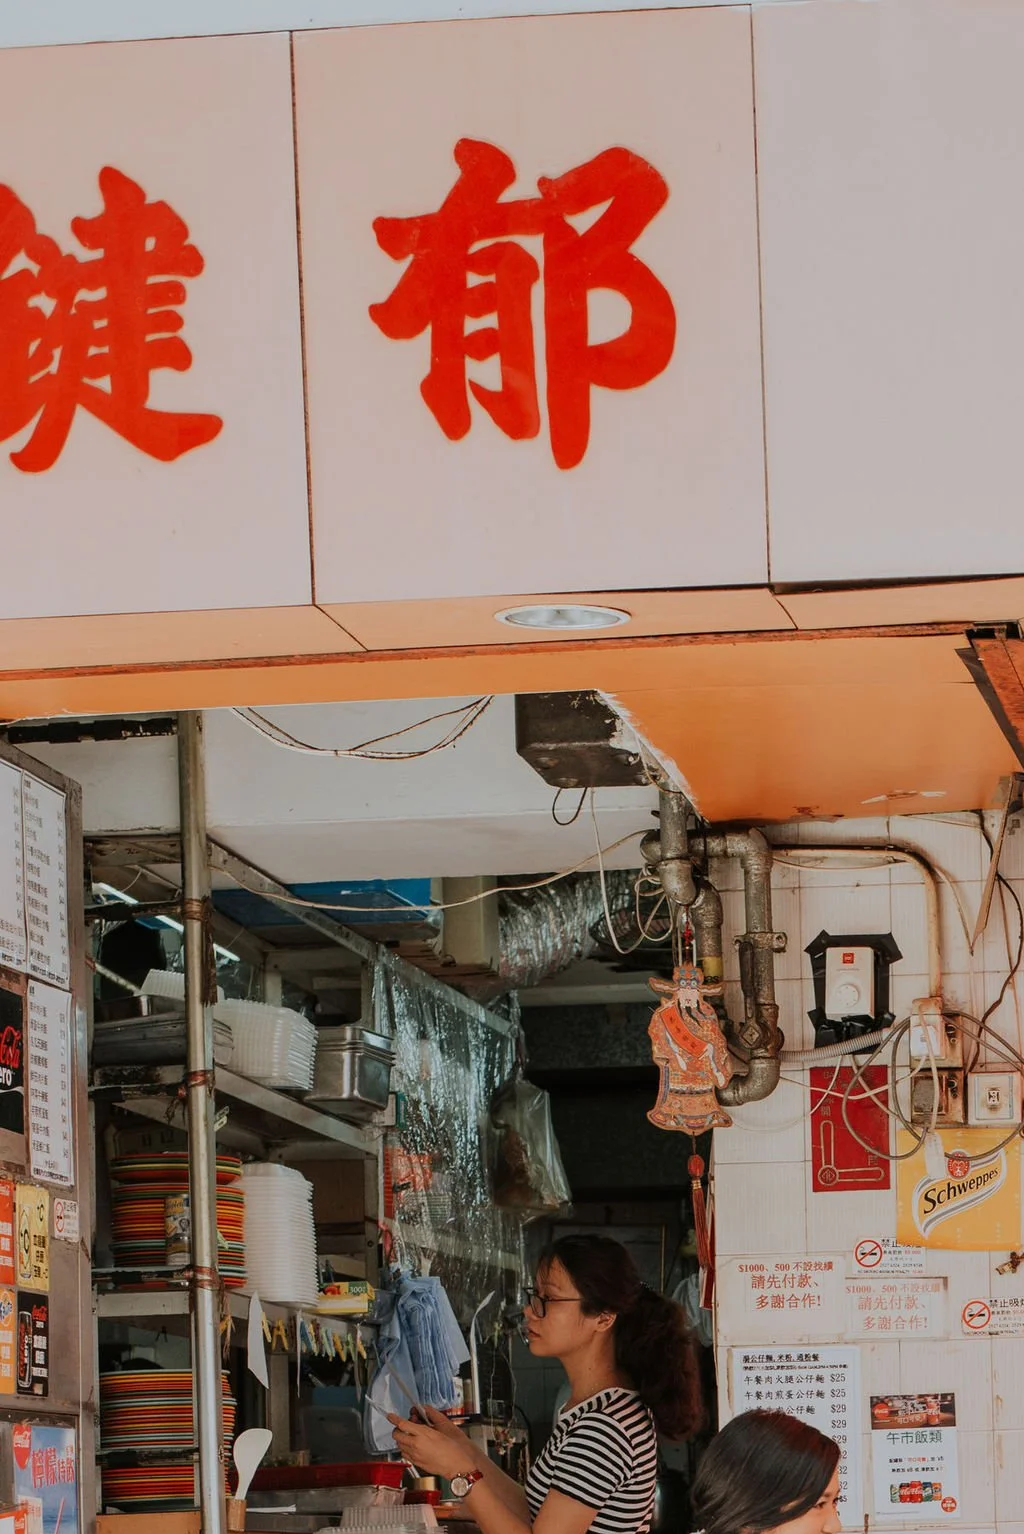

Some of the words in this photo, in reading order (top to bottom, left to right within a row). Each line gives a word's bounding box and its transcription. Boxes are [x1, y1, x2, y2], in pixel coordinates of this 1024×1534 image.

[923, 1168, 1000, 1214] Schweppes
[755, 1292, 821, 1310] 多謝合作!
[863, 1314, 928, 1330] 多謝合作!
[830, 1372, 846, 1382] $25
[830, 1388, 846, 1398] $25
[830, 1403, 847, 1414] $29
[831, 1419, 847, 1429] $29
[886, 1430, 943, 1445] 午市飯類
